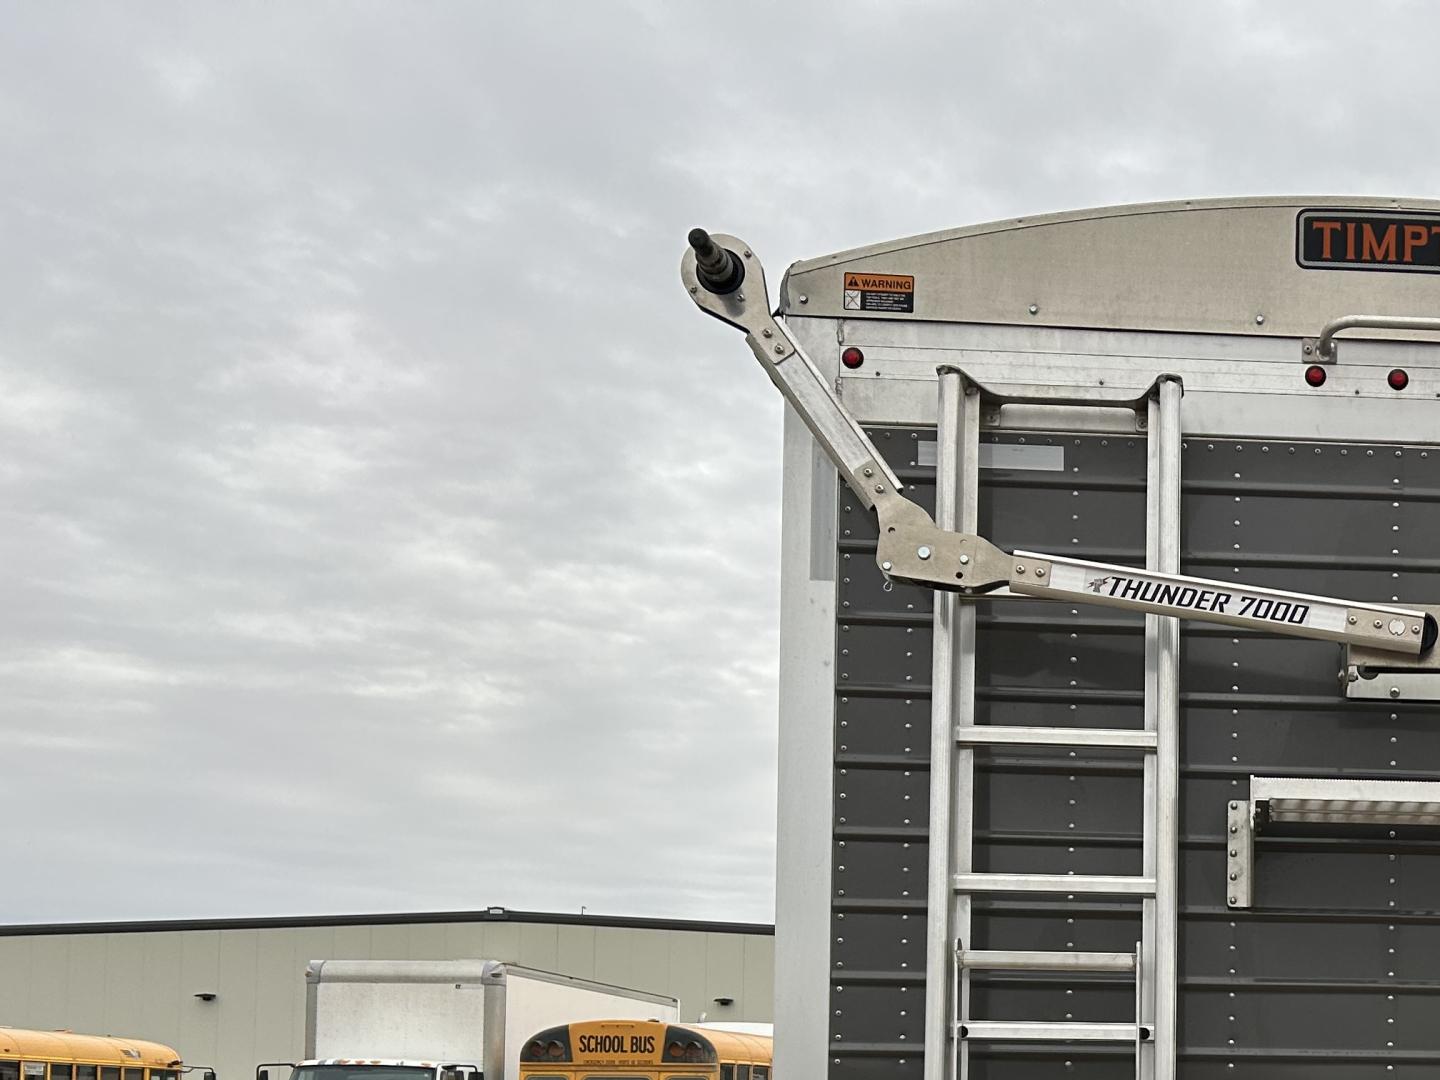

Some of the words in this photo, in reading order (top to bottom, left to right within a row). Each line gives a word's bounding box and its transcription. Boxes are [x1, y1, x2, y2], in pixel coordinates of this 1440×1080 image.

[861, 279, 911, 290] WARNING
[1108, 576, 1232, 613] THUNDER
[1238, 596, 1310, 625] 7000
[578, 1035, 628, 1054] SCHOOL
[630, 1035, 655, 1054] BUS
